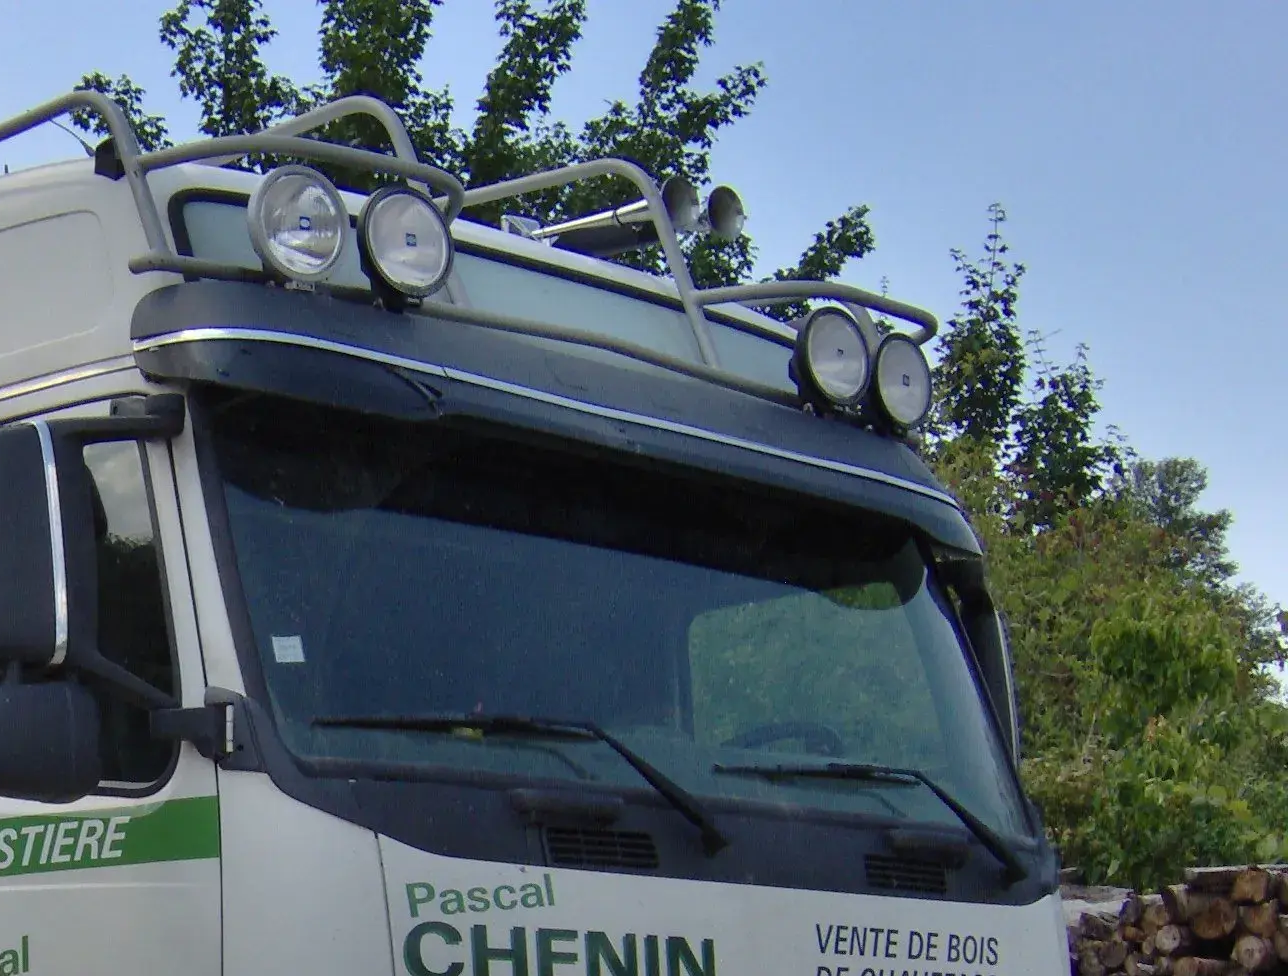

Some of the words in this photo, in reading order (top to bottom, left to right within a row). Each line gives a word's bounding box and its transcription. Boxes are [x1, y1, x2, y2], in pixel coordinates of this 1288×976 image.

[404, 873, 556, 918] Pascal
[815, 923, 899, 958] VENTE
[908, 930, 939, 961] DE
[947, 933, 999, 966] BOIS
